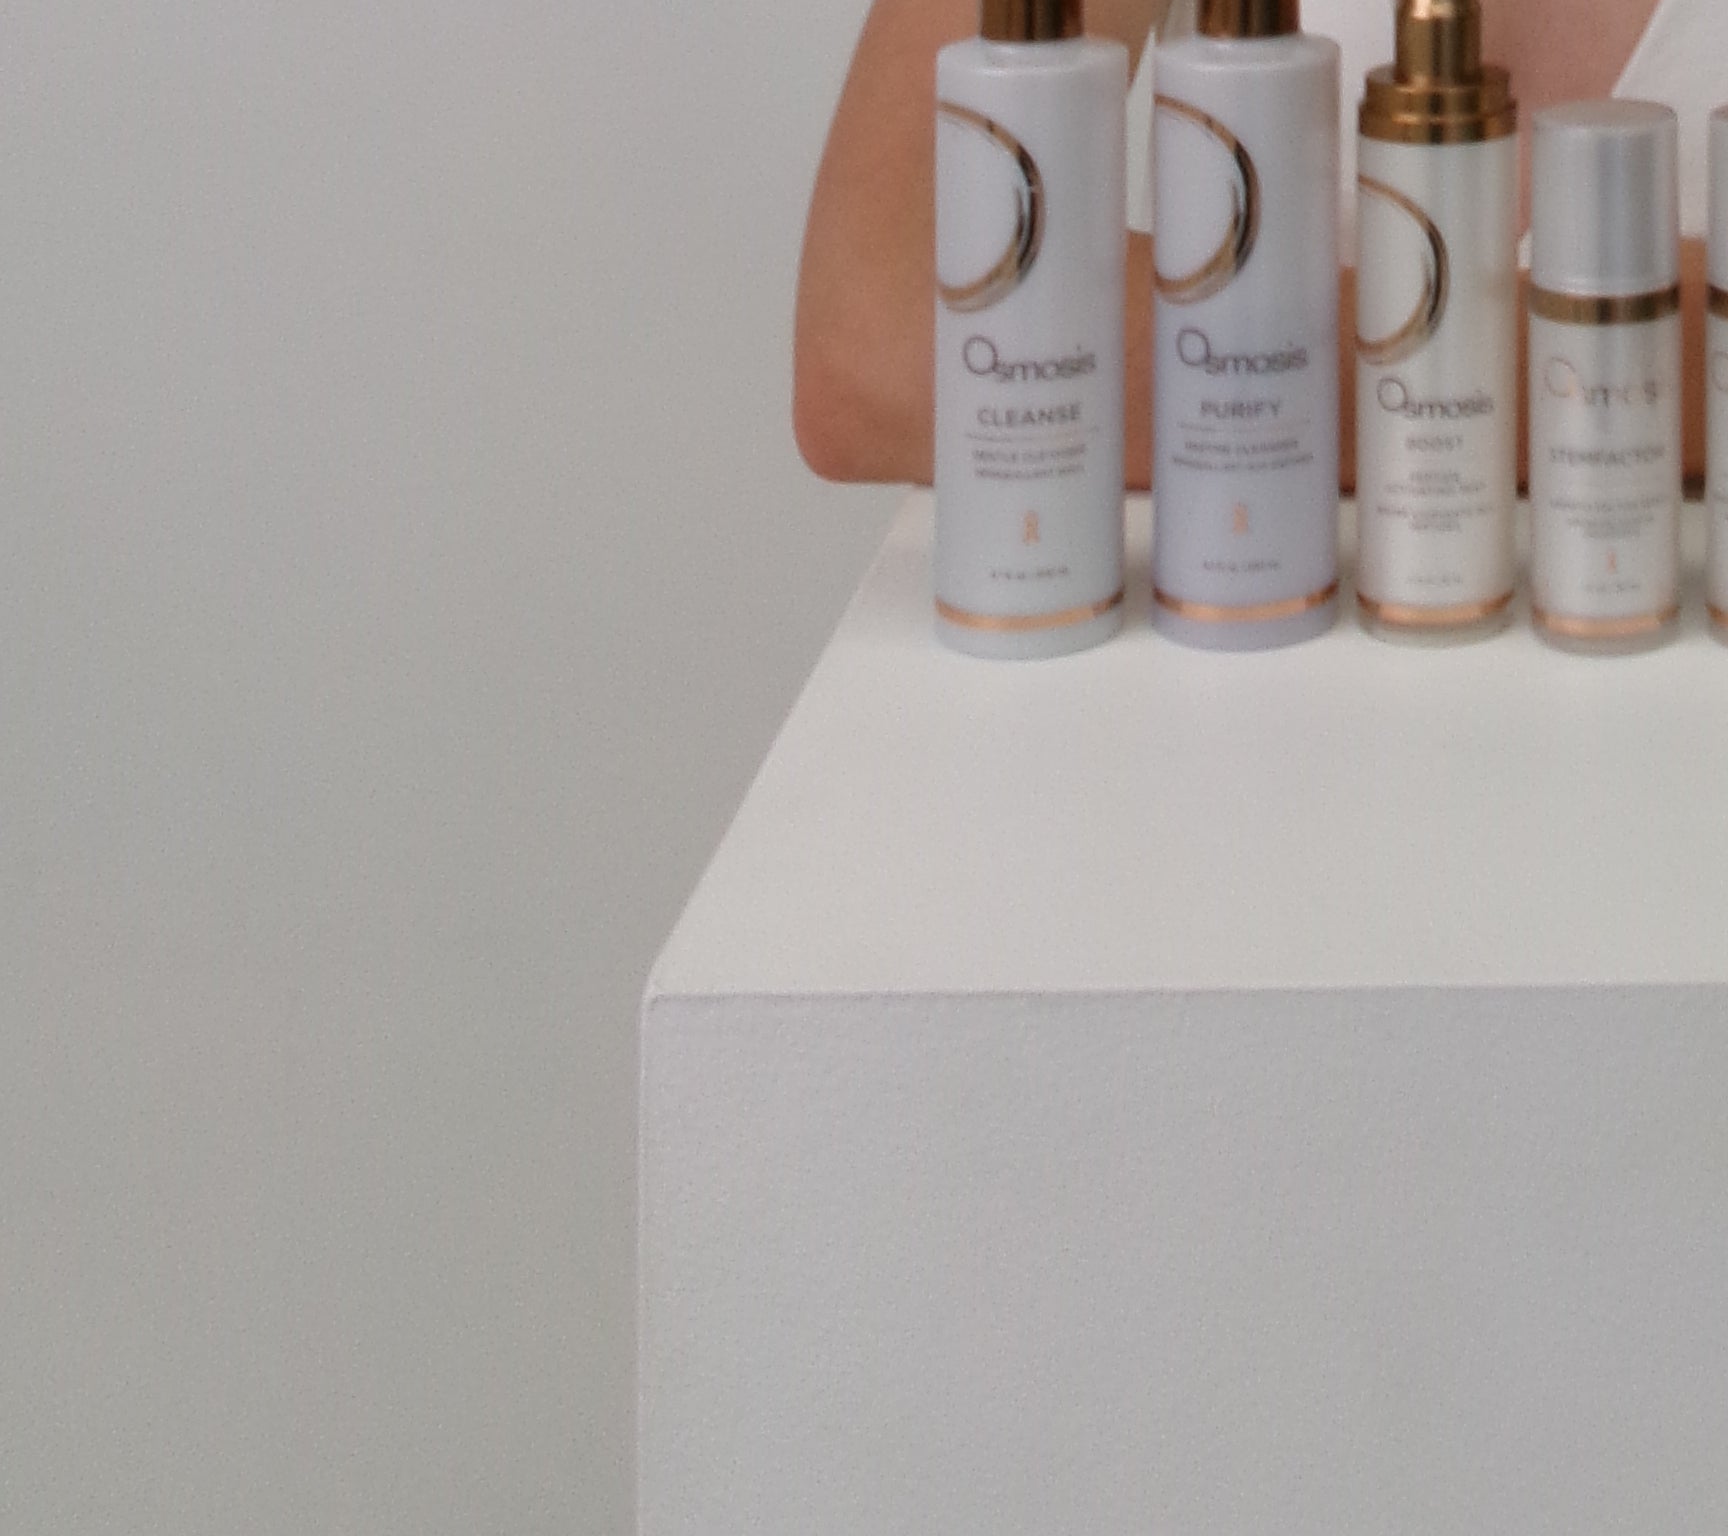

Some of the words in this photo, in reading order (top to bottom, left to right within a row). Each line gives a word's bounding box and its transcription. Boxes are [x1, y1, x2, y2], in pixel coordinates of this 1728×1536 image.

[963, 335, 1096, 383] Osmosis
[1176, 328, 1308, 376] Osmosis
[977, 402, 1082, 427] CLEANSE
[1201, 399, 1282, 419] PURIFY
[1376, 377, 1494, 419] Osmosis
